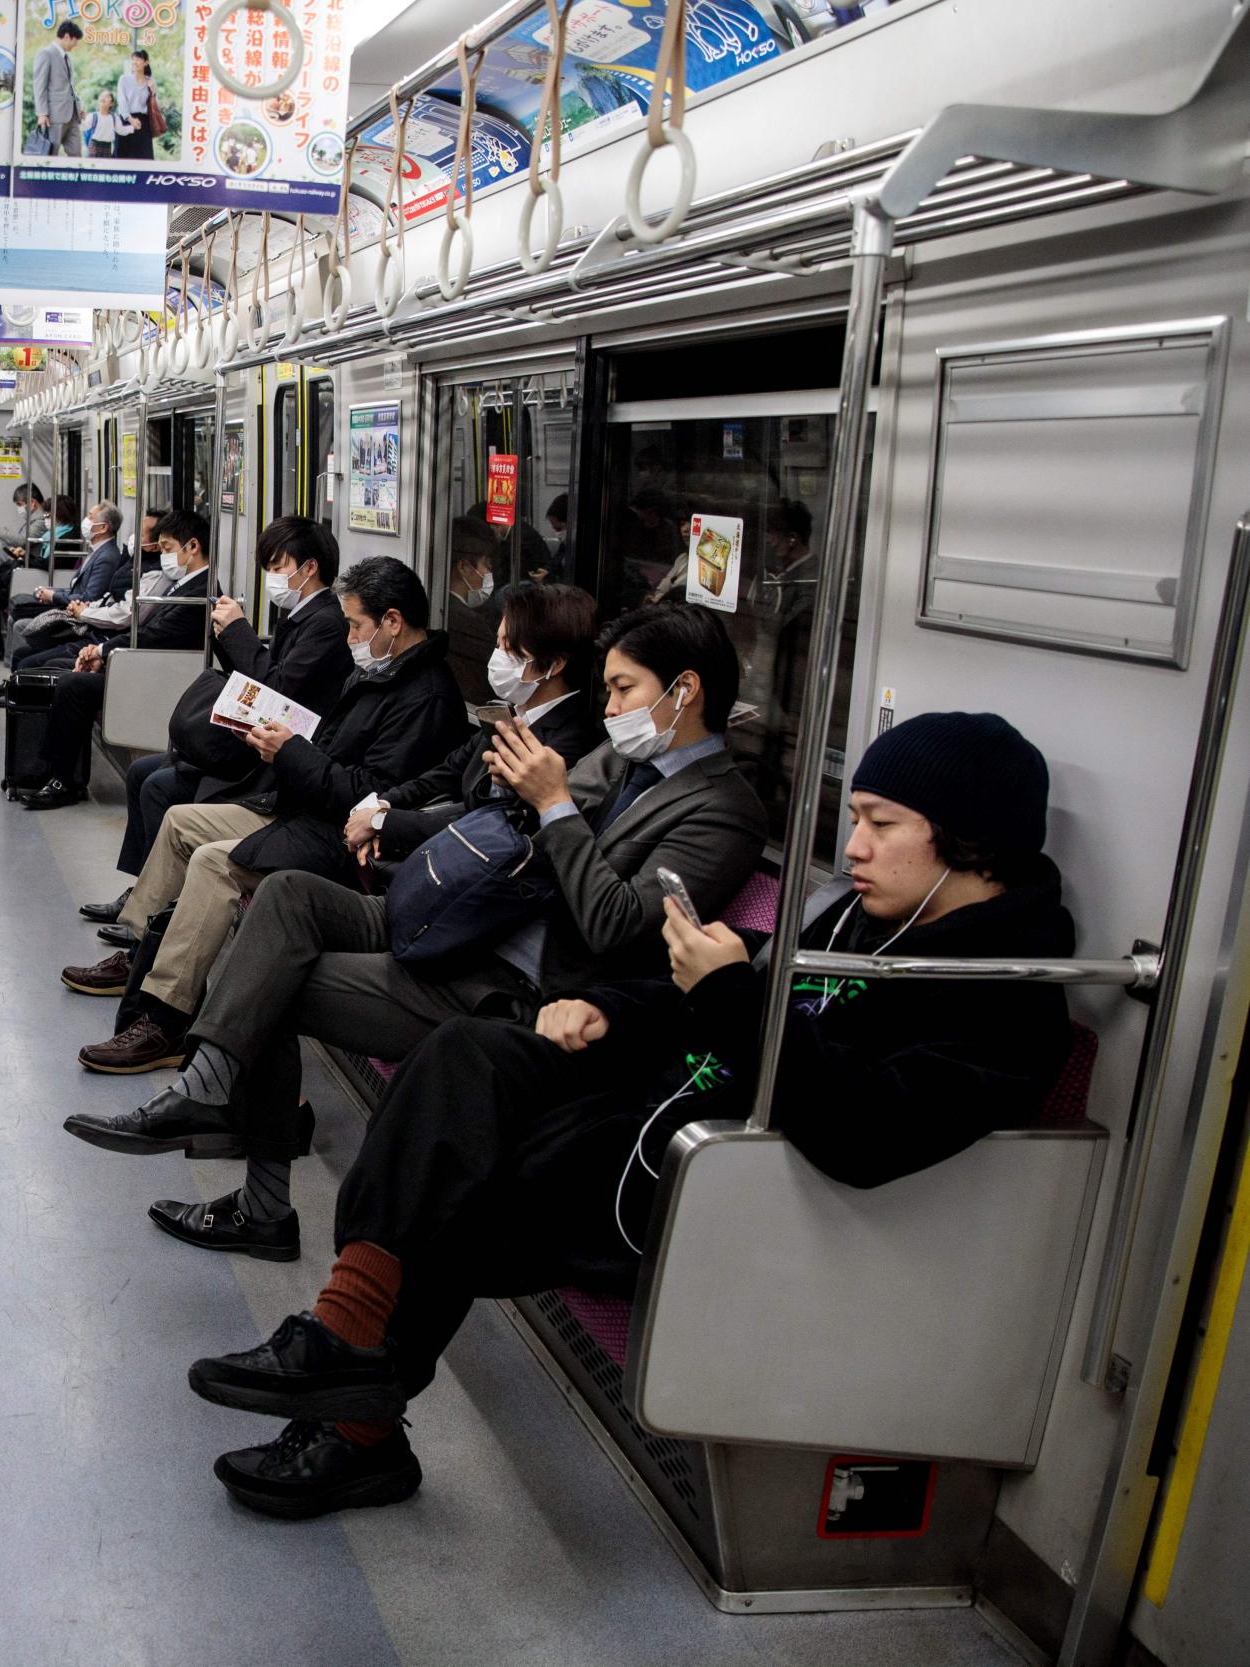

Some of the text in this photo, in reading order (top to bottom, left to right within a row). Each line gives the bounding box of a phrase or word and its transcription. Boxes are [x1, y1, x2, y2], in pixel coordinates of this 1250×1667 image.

[85, 25, 131, 46] Smile
[145, 174, 217, 188] HOKSO
[461, 177, 481, 192] HSO
